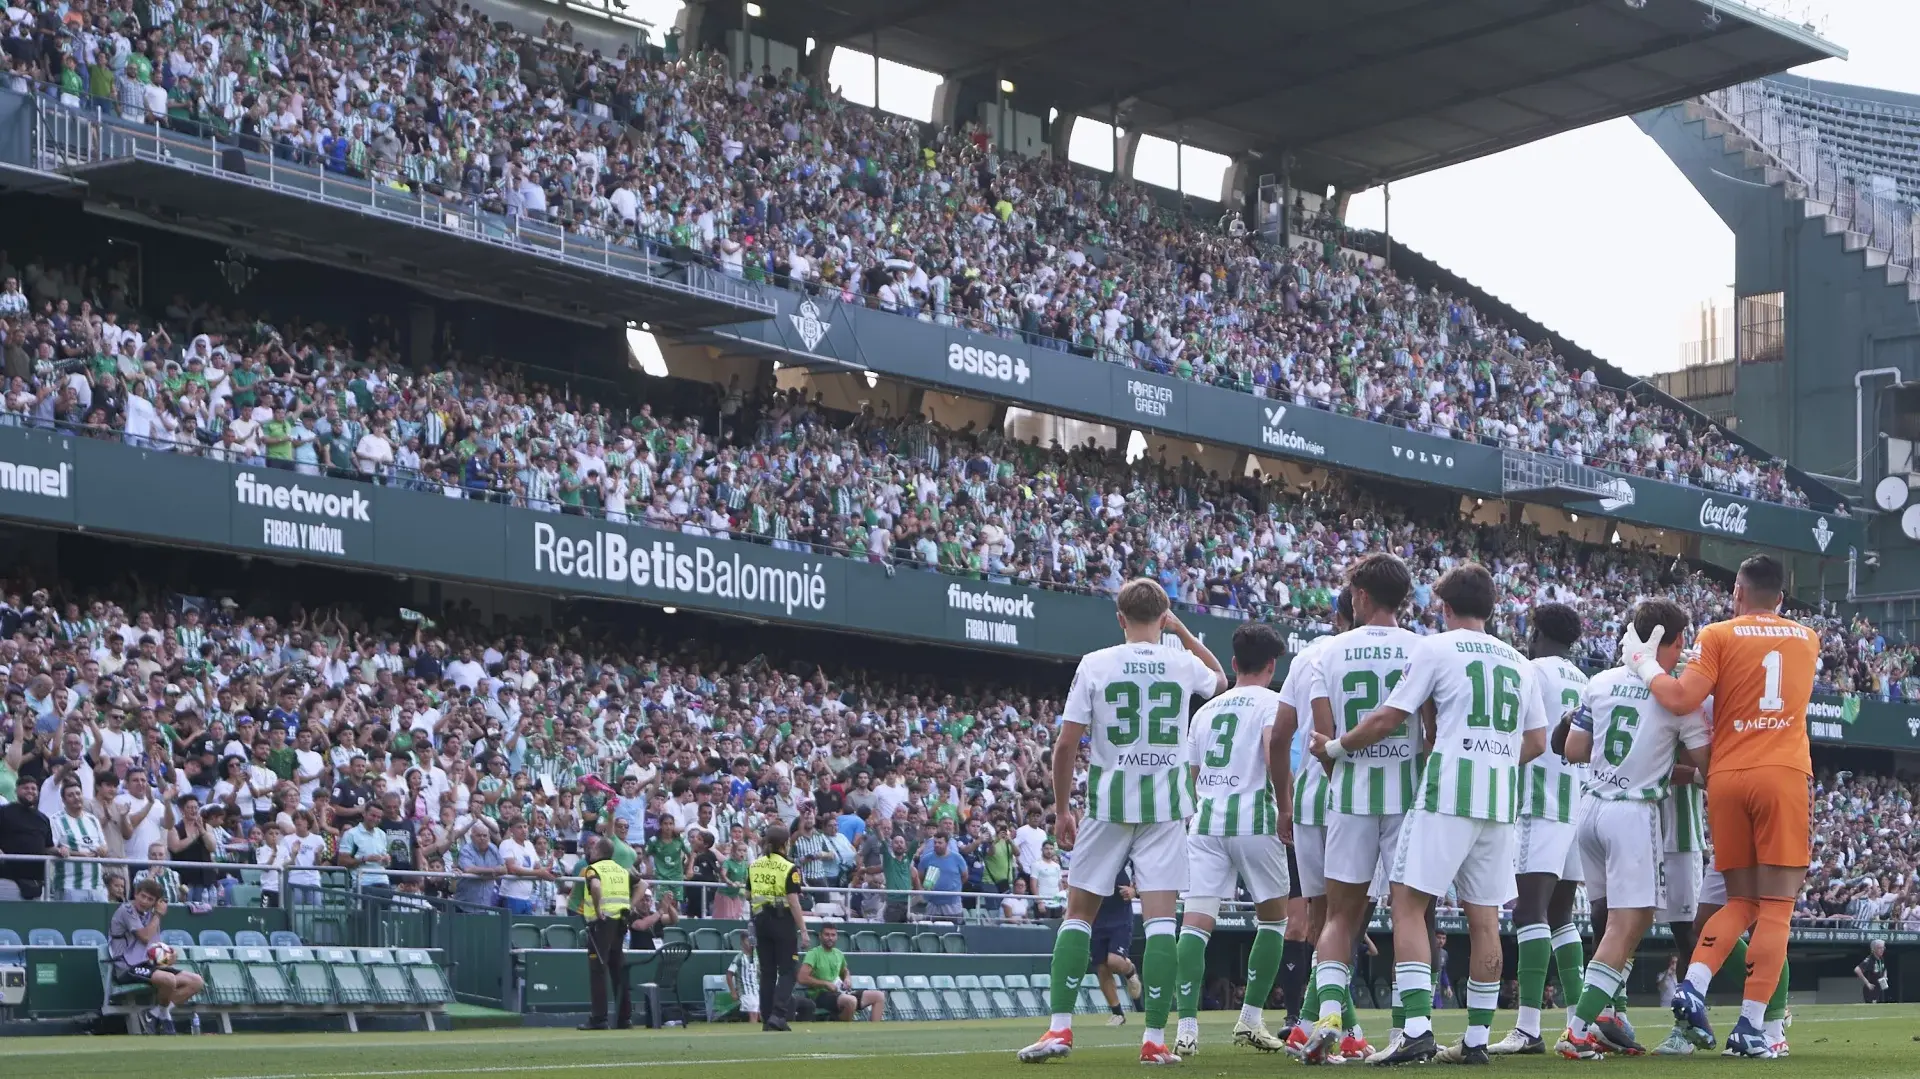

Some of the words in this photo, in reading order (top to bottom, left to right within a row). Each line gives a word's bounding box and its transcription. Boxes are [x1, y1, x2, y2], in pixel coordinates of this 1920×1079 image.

[1127, 380, 1173, 403] FOREVER
[1135, 397, 1166, 417] GREEN
[1391, 445, 1454, 467] VOLVO
[235, 472, 371, 522] finetwork
[263, 518, 299, 548] FIBRA
[299, 523, 308, 549] Y
[308, 523, 346, 555] MÓVIL
[948, 583, 1035, 619] finetwork
[966, 618, 989, 640] FIBRA
[995, 620, 1018, 645] MÓVIL
[1345, 646, 1391, 661] LUCAS
[1394, 645, 1408, 660] A.
[1610, 684, 1650, 700] MATEO
[1759, 650, 1784, 712] 1
[1465, 660, 1522, 735] 16
[1105, 681, 1183, 747] 32
[1744, 716, 1795, 732] MEDAC
[1204, 712, 1239, 769] 3
[1603, 705, 1640, 767] 6
[1124, 753, 1177, 766] MEDAC
[1357, 744, 1410, 758] MEDAC
[1199, 775, 1240, 787] MEDAC
[753, 873, 777, 885] 2383
